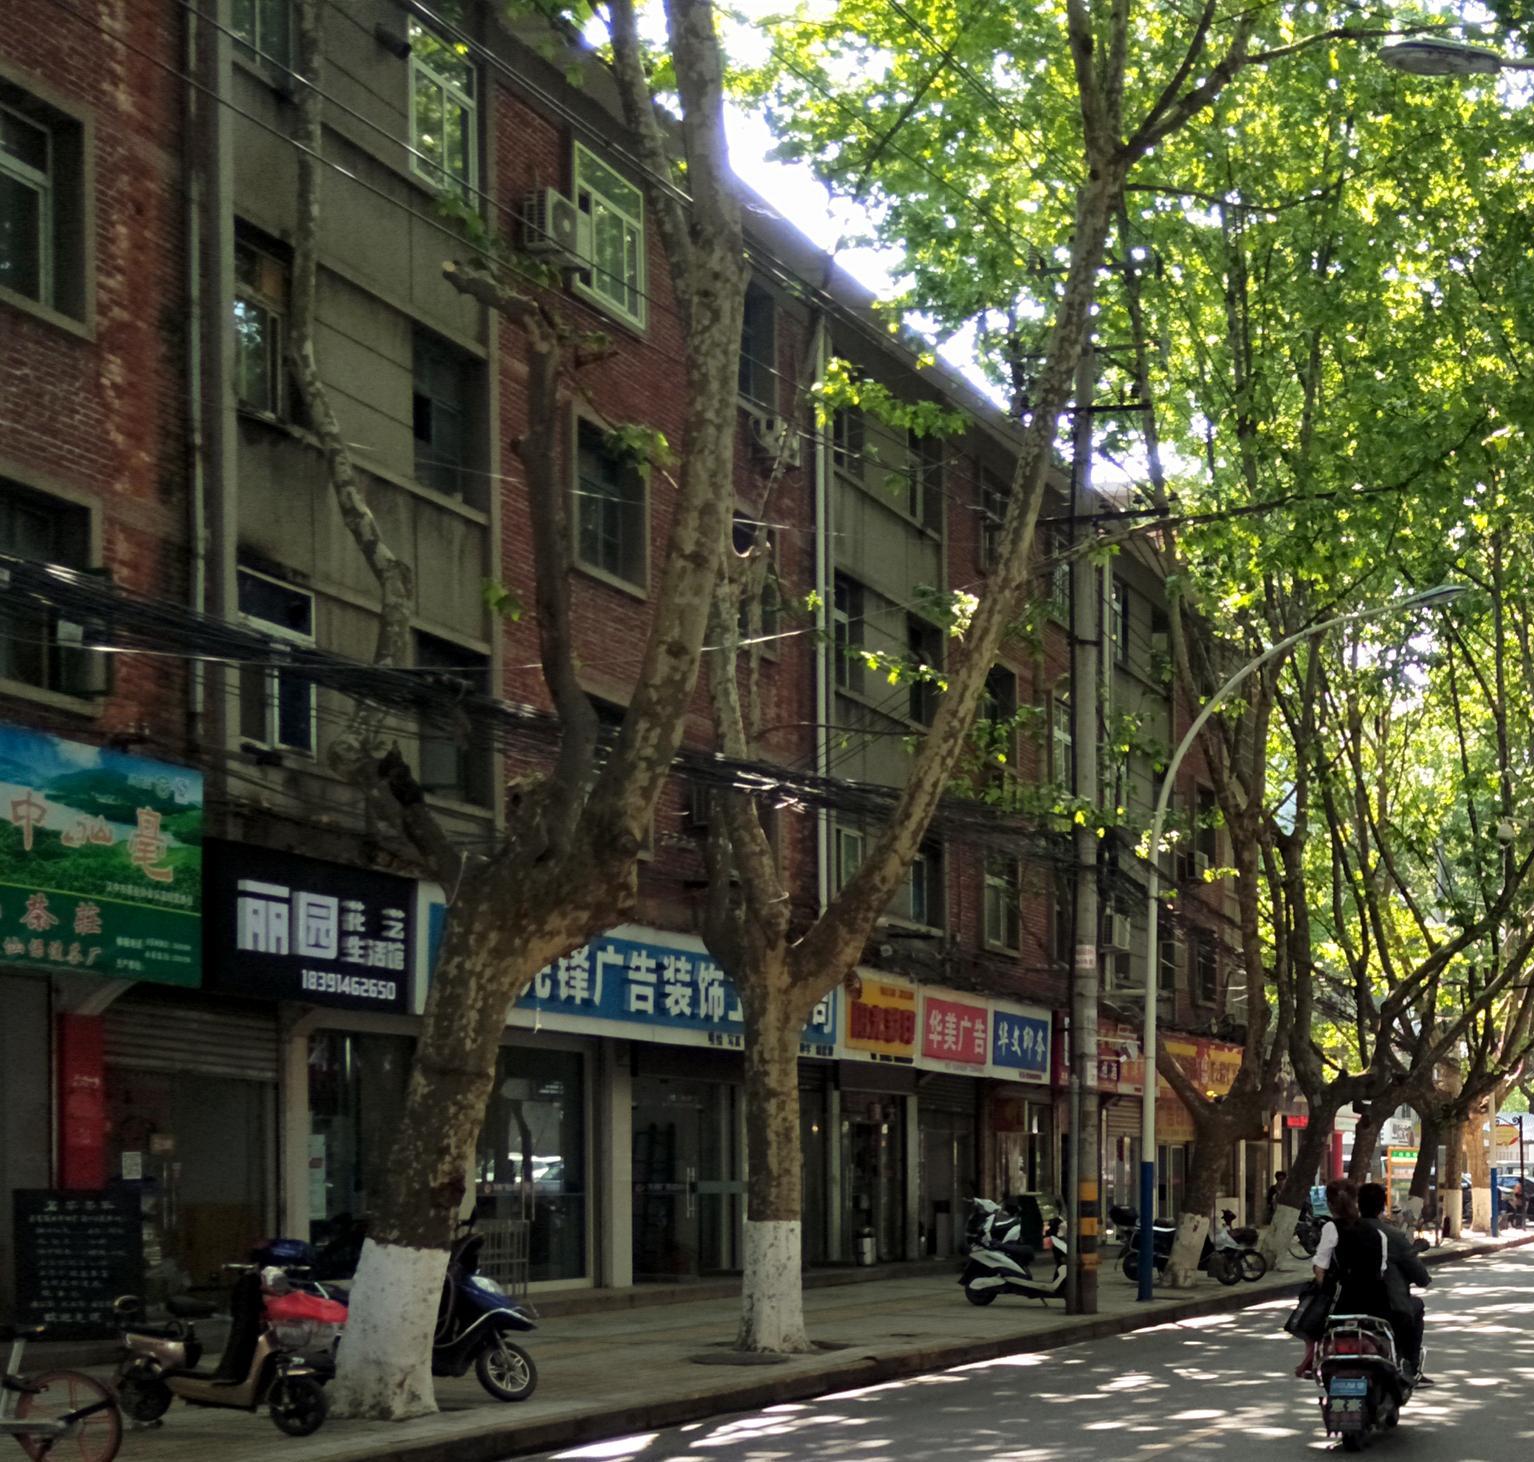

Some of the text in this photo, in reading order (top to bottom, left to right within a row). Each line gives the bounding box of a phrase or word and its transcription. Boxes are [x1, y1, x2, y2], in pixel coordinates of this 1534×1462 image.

[237, 879, 339, 960] 丽园
[340, 935, 405, 971] 生活馆
[302, 969, 396, 1000] 18391462650
[928, 1009, 986, 1056] 华美广告
